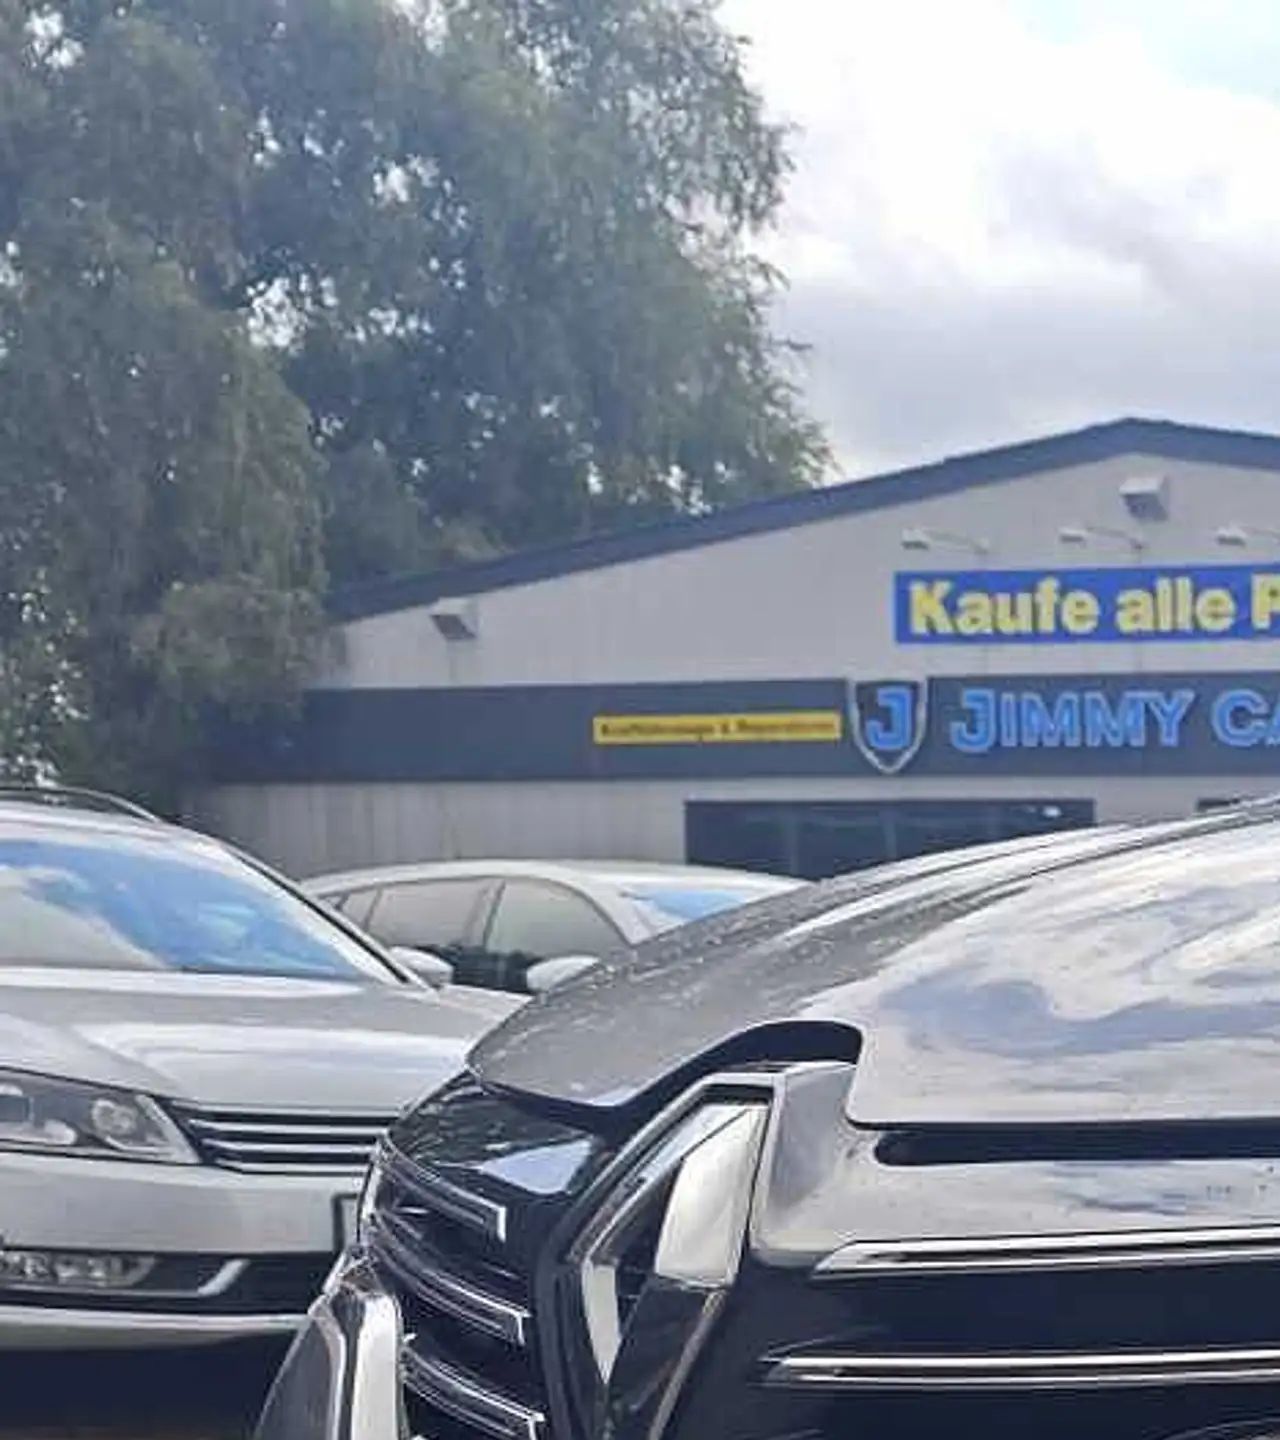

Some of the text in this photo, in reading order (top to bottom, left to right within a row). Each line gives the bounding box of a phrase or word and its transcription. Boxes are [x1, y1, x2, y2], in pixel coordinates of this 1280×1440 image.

[908, 577, 1100, 635] Kaufe
[1115, 578, 1239, 634] alle
[950, 686, 1195, 752] JIMMY
